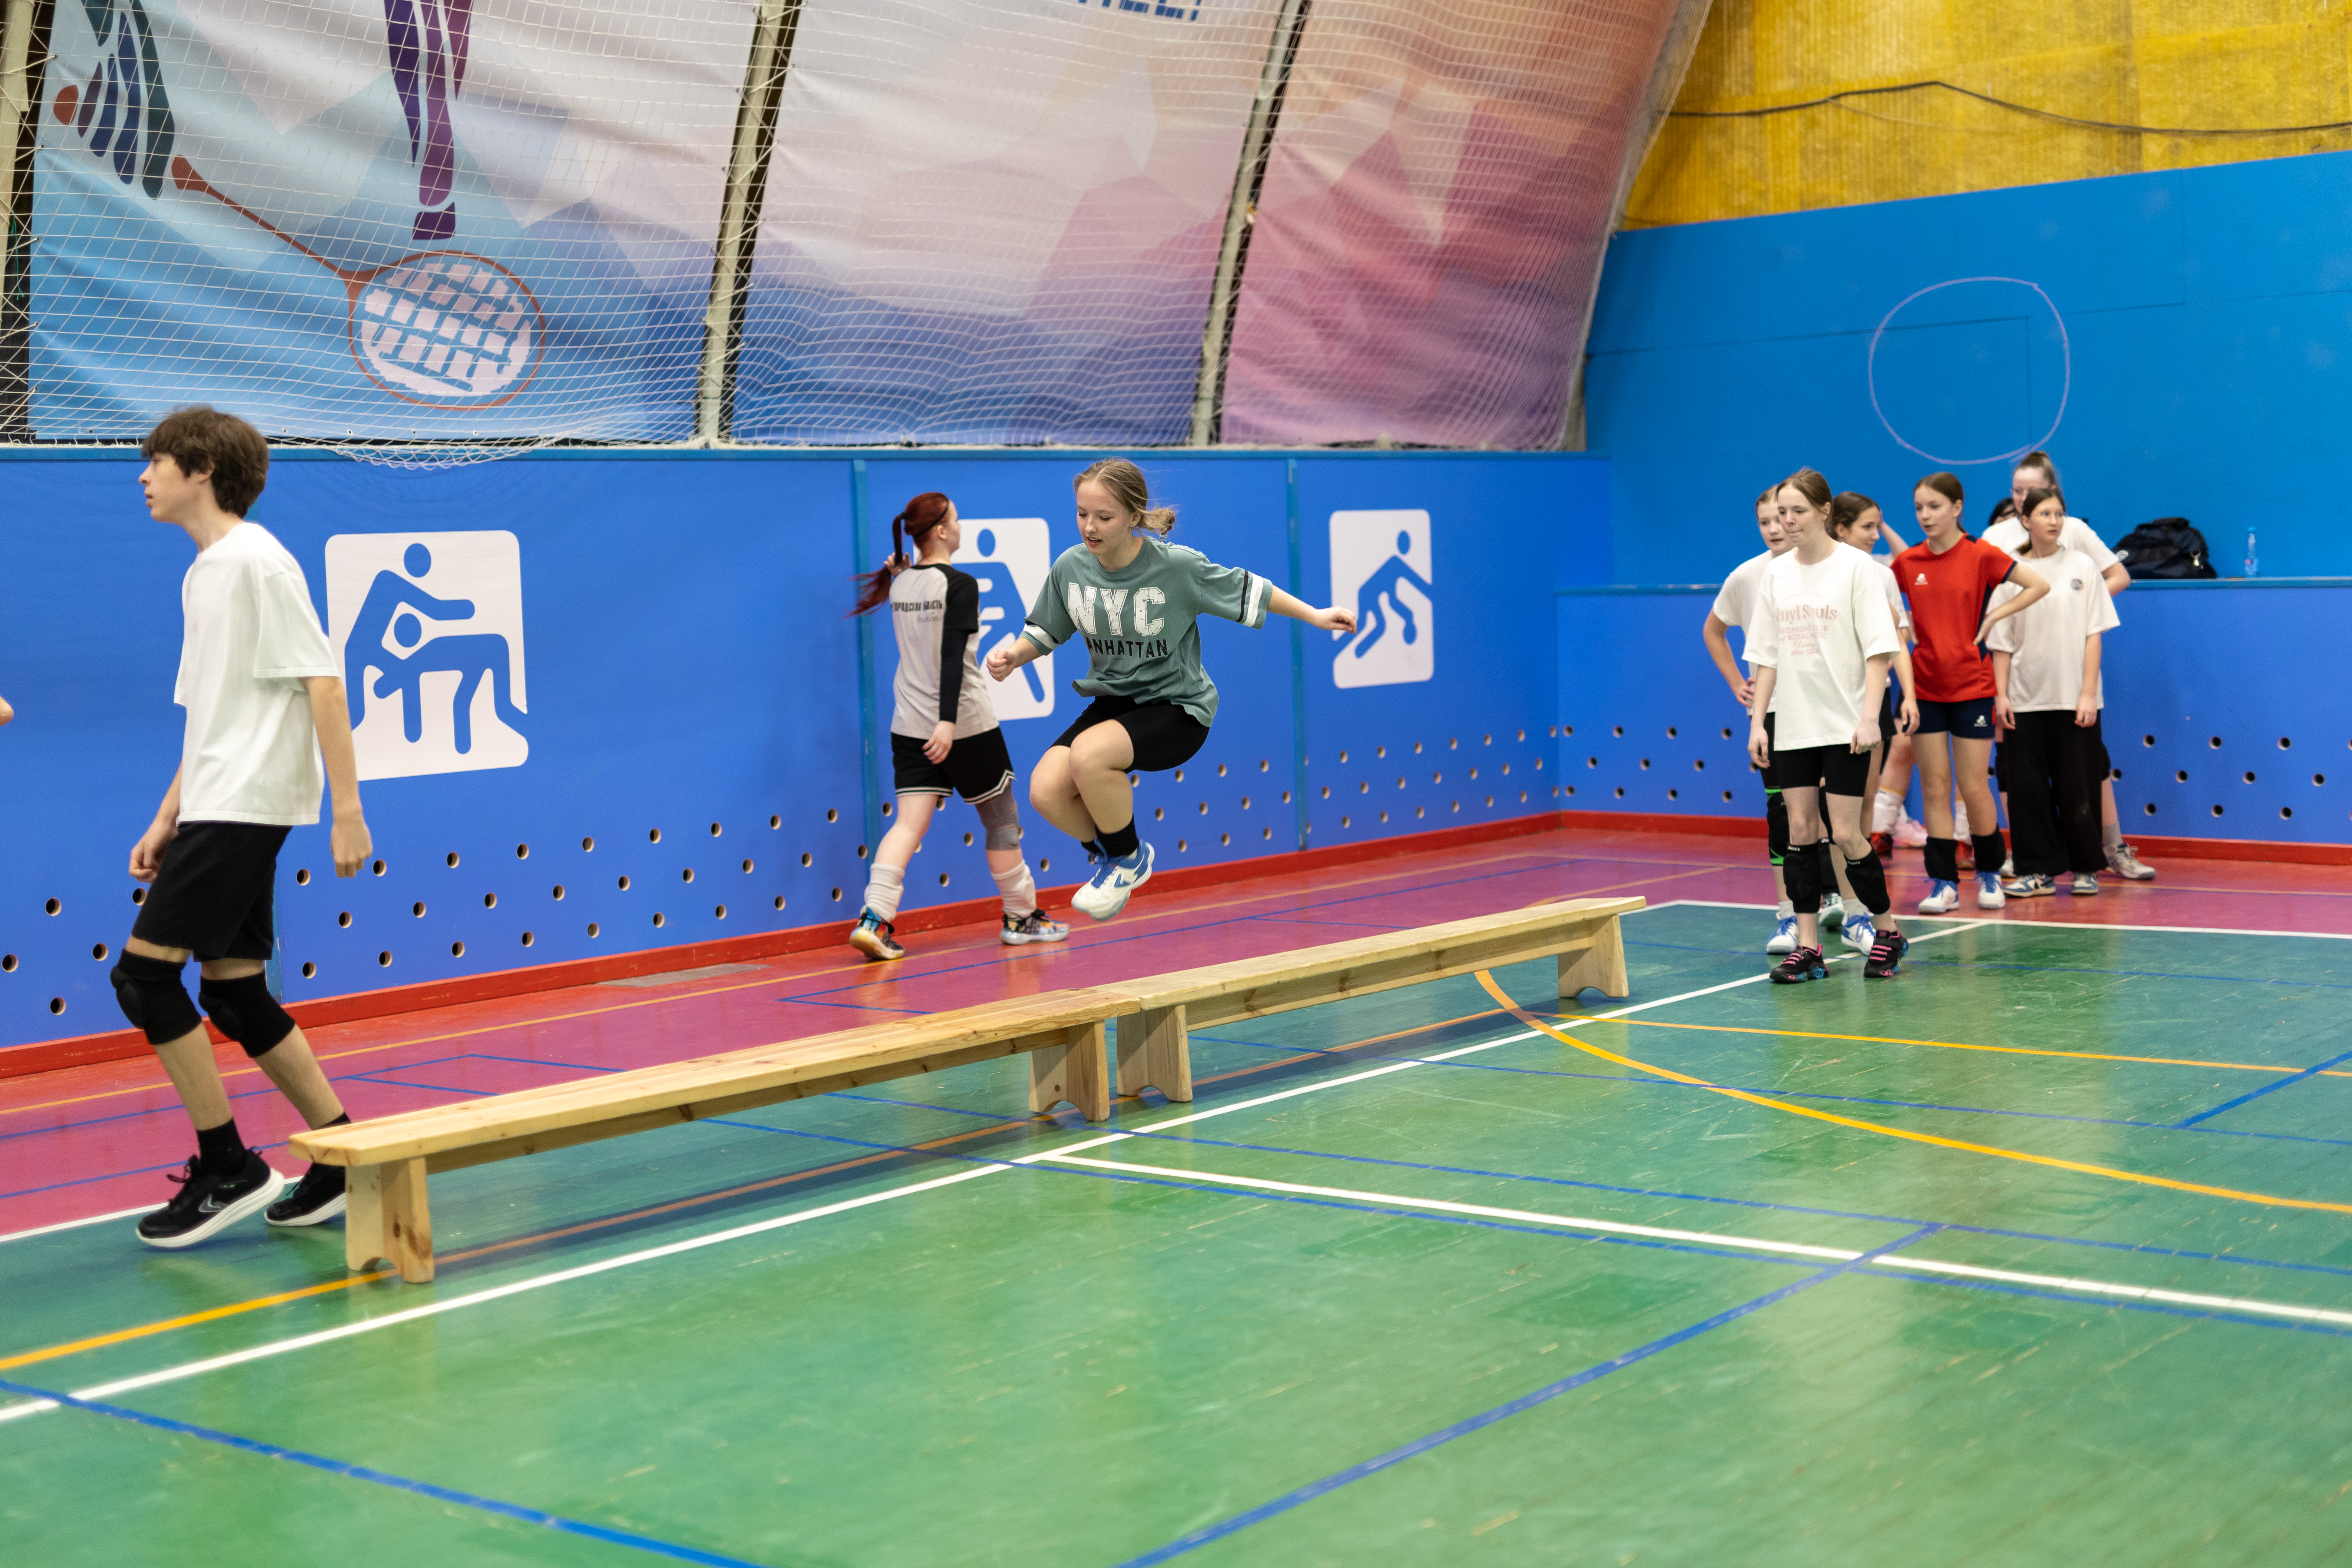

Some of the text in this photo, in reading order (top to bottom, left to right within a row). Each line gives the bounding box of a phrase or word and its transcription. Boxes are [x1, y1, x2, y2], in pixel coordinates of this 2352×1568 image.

[1068, 582, 1165, 637] NYC
[1802, 604, 1837, 620] Souls
[1779, 625, 1812, 633] MIDNIGHT
[1086, 637, 1168, 658] ANHATTAN
